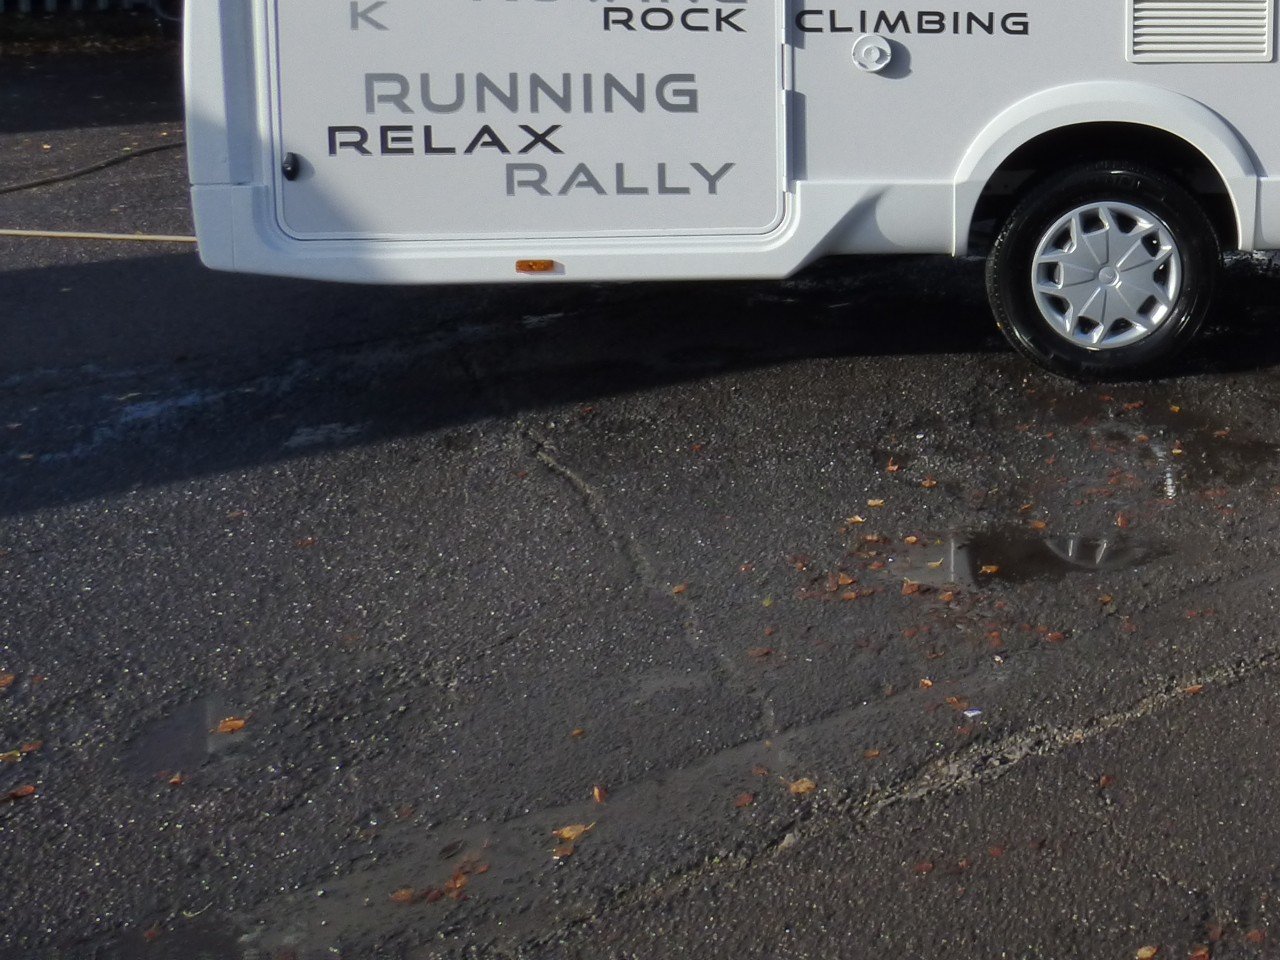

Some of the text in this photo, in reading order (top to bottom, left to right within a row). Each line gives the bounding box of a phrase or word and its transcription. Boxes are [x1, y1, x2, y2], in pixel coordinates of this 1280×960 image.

[603, 7, 1029, 35] ROCK CLIMBING
[364, 72, 699, 115] RUNNING
[327, 124, 564, 157] RELAX
[504, 162, 736, 197] RALLY
